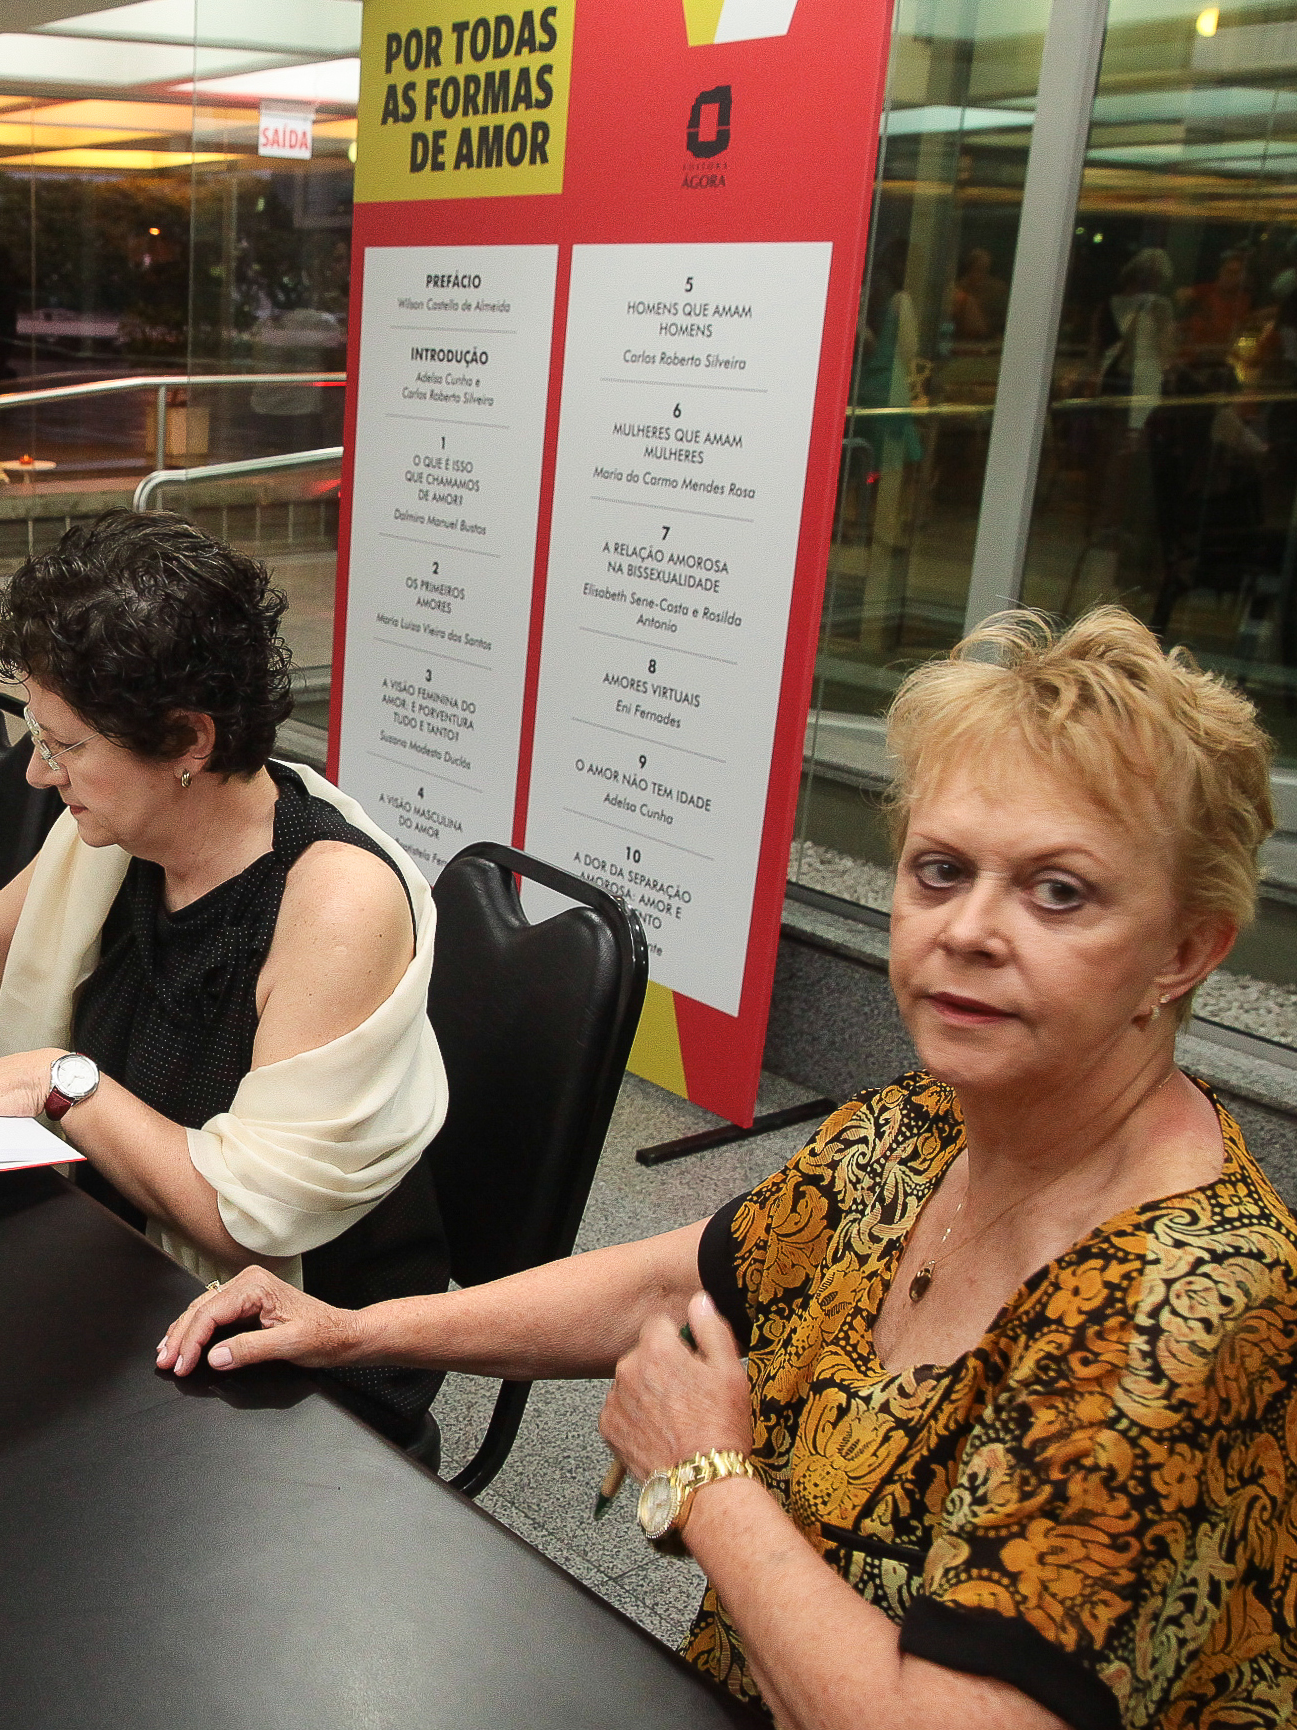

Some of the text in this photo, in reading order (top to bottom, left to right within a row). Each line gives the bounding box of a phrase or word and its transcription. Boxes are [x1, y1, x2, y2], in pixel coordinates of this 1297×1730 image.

[385, 6, 557, 74] POR TODAS
[381, 64, 554, 126] AS FORMAS
[262, 123, 308, 150] SAÍDA
[409, 120, 549, 173] DE AMOR
[681, 173, 726, 189] ÁGORA
[425, 271, 482, 289] PREFÁCIO
[684, 276, 694, 293] 5
[397, 296, 424, 310] Wilson
[461, 298, 472, 311] de
[474, 299, 511, 313] Almeida
[626, 300, 753, 319] HOMENS QUE AMAM
[658, 322, 713, 338] HOMENS
[410, 346, 489, 368] INTRODUÇÃO
[623, 349, 746, 370] Carlos Roberto Silveira
[445, 372, 473, 386] Cunha
[475, 379, 480, 387] e
[402, 386, 494, 406] Carlos Roberto Silveira
[673, 403, 682, 419] 6
[441, 436, 446, 450] 1
[612, 422, 743, 448] MULHERES QUE AMAM
[413, 455, 421, 466] O
[423, 456, 442, 469] QUE
[452, 460, 473, 473] ISSO
[643, 446, 704, 464] MULHERES
[405, 470, 480, 492] QUE CHAMAMOS
[593, 466, 624, 482] Maria
[642, 471, 678, 489] Carmo
[680, 476, 725, 496] Mendes
[728, 483, 756, 499] Rosa
[418, 489, 463, 506] DE AMOR?
[394, 508, 486, 535] Dalmiro Manuel Bustos
[661, 526, 671, 541] 7
[432, 562, 440, 575] 2
[602, 541, 729, 575] A RELAÇÃO AMOROSA
[607, 560, 720, 594] NA BISSEXUALIDADE
[405, 576, 465, 600] OS PRIMEIROS
[416, 596, 452, 614] AMORES
[582, 582, 743, 627] Elisabeth Sene-Costa e Rosilda
[376, 612, 399, 627] Maria
[423, 623, 446, 639] Vieira
[448, 630, 462, 643] dos
[465, 633, 492, 651] Santos
[636, 613, 678, 634] Antonio
[425, 669, 432, 682] 3
[647, 659, 656, 674] 8
[382, 678, 476, 714] A VISÃO FEMININA DO
[602, 673, 702, 708] AMORES VIRTUAIS
[418, 703, 474, 731] PORVENTURA
[615, 700, 632, 714] Eni
[393, 711, 417, 728] TUDO
[419, 720, 424, 731] E
[408, 740, 442, 760] Modesto
[638, 755, 647, 769] 9
[417, 787, 424, 799] 4
[574, 758, 712, 813] O AMOR NÃO TEM IDADE
[379, 793, 463, 832] A VISÃO MASCULINA
[603, 793, 674, 826] Adelsa Cunha
[398, 815, 440, 840] DO AMOR
[626, 846, 641, 863] 10
[574, 851, 692, 903] A DOR DA SEPARAÇÃO
[639, 895, 673, 915] AMOR
[676, 907, 682, 919] E
